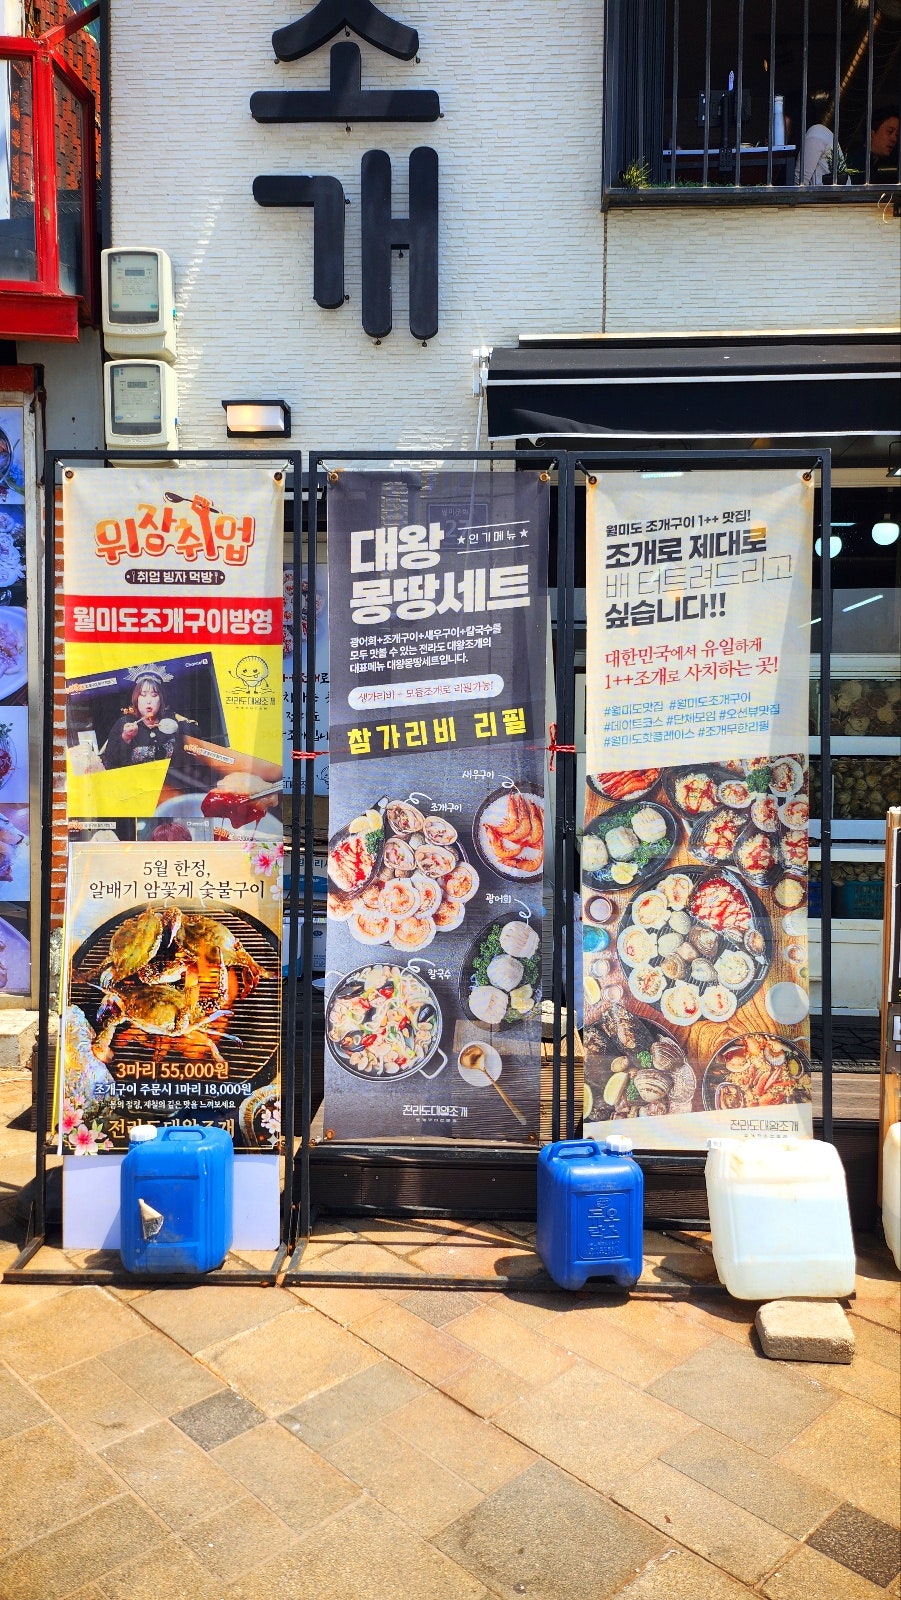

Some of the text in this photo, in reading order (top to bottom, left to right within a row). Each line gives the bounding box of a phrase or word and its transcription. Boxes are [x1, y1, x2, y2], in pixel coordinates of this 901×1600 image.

[95, 499, 256, 566] 위장취업
[605, 509, 751, 538] 월미도 조개구이 1++ 맛집!
[350, 522, 445, 573] 대왕
[605, 527, 767, 569] 조개로 제대로
[137, 571, 214, 583] 취업 빙자 먹방
[606, 555, 793, 598] 배 터트려드리고
[350, 565, 531, 624] 몽땅세트
[73, 606, 273, 634] 월미도조개구이방영
[605, 592, 726, 630] 싶습니다!!
[350, 637, 492, 661] 모두 맛볼 수 있는 전라도 대왕조개의
[605, 637, 762, 668] 대한민국에서 유일하게
[350, 653, 469, 673] 대표메뉴 대왕몽땅세트입니다.
[604, 656, 779, 689] 1++조개로 사치하는 곳!
[454, 680, 494, 693] 리필가능!
[604, 692, 751, 717] #월미도맛집 #월미도조개구이
[347, 707, 527, 755] 참가리비 리필
[604, 716, 664, 731] #데이트코스
[666, 711, 716, 726] #단체모임
[604, 720, 769, 747] #월미도핫플레이스 #조개무한리필
[462, 770, 495, 779] 새우구이
[430, 802, 463, 813] 조개구이
[143, 860, 210, 878] 5월 한정,
[90, 881, 265, 900] 알배기 암꽃게 숯불구이
[485, 893, 512, 904] 광어회
[428, 969, 451, 979] 칼국수
[116, 1062, 229, 1080] 3마리 55,000원
[95, 1083, 252, 1097] 조개구이 주문시 1마리 18,000원
[199, 1100, 236, 1109] 느껴보세요
